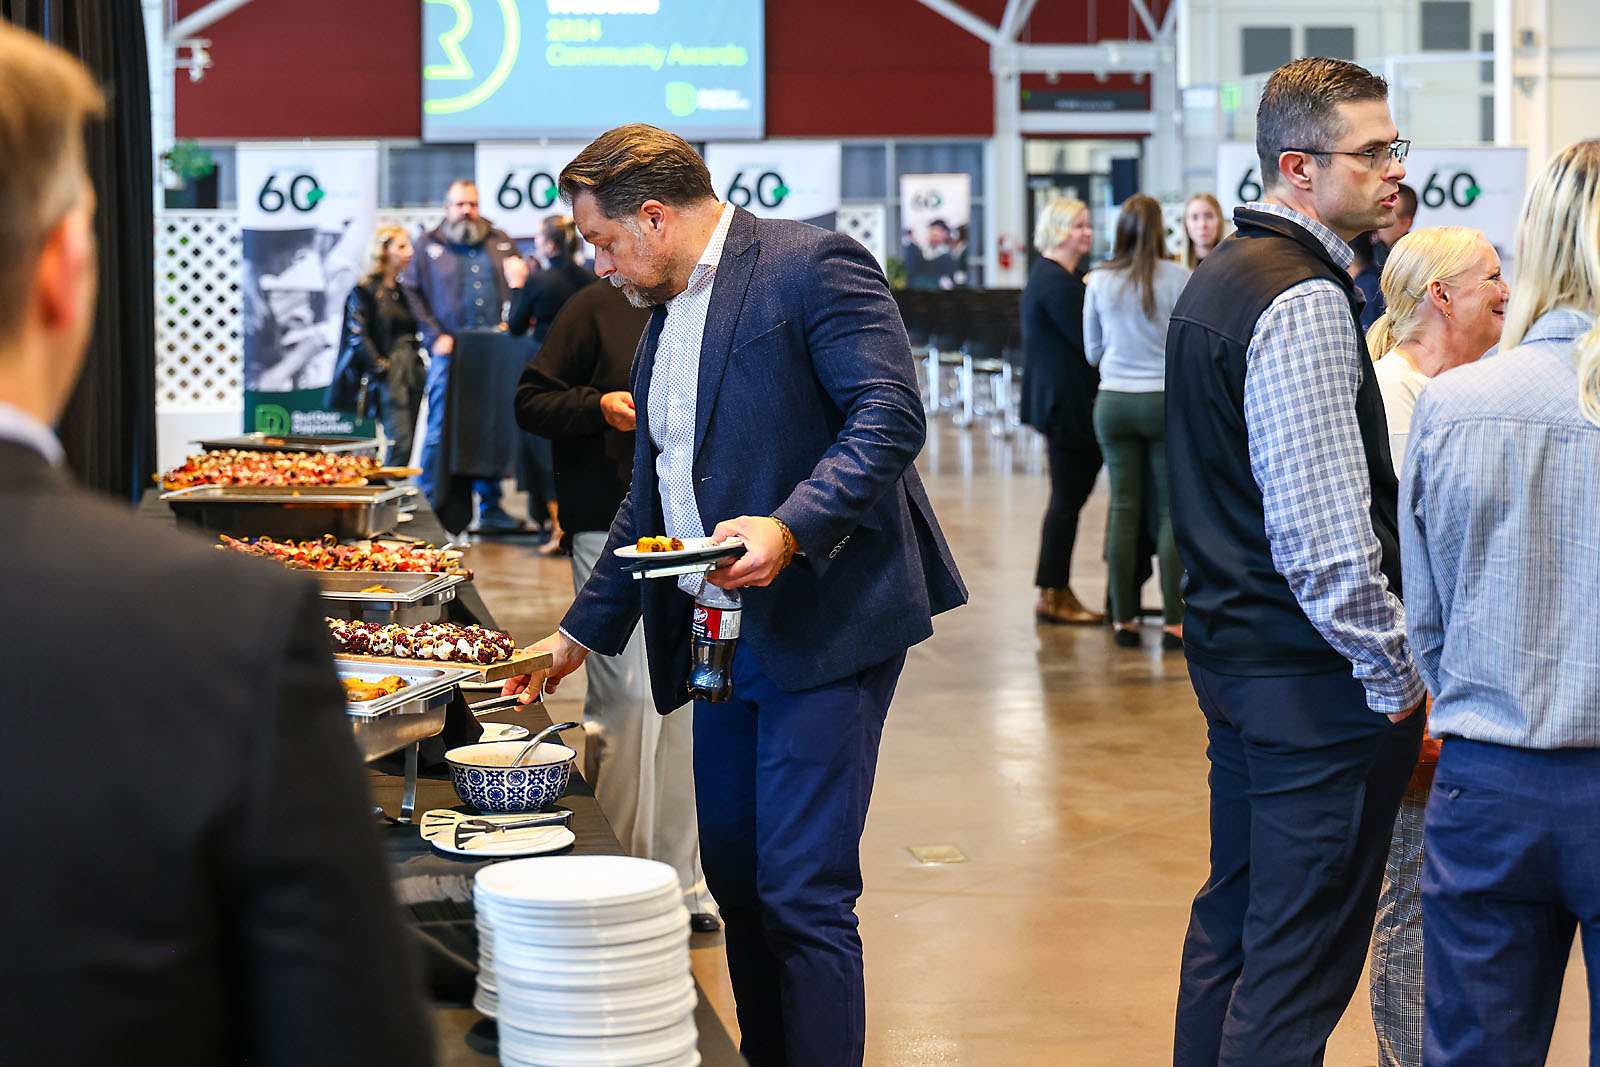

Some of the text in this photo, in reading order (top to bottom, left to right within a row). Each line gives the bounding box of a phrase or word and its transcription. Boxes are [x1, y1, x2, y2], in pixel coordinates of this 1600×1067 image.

[546, 42, 748, 70] Community Awards
[258, 174, 320, 212] 60
[497, 172, 556, 209] 60
[727, 172, 784, 208] 60
[1238, 168, 1262, 203] 6
[1422, 172, 1477, 208] 60
